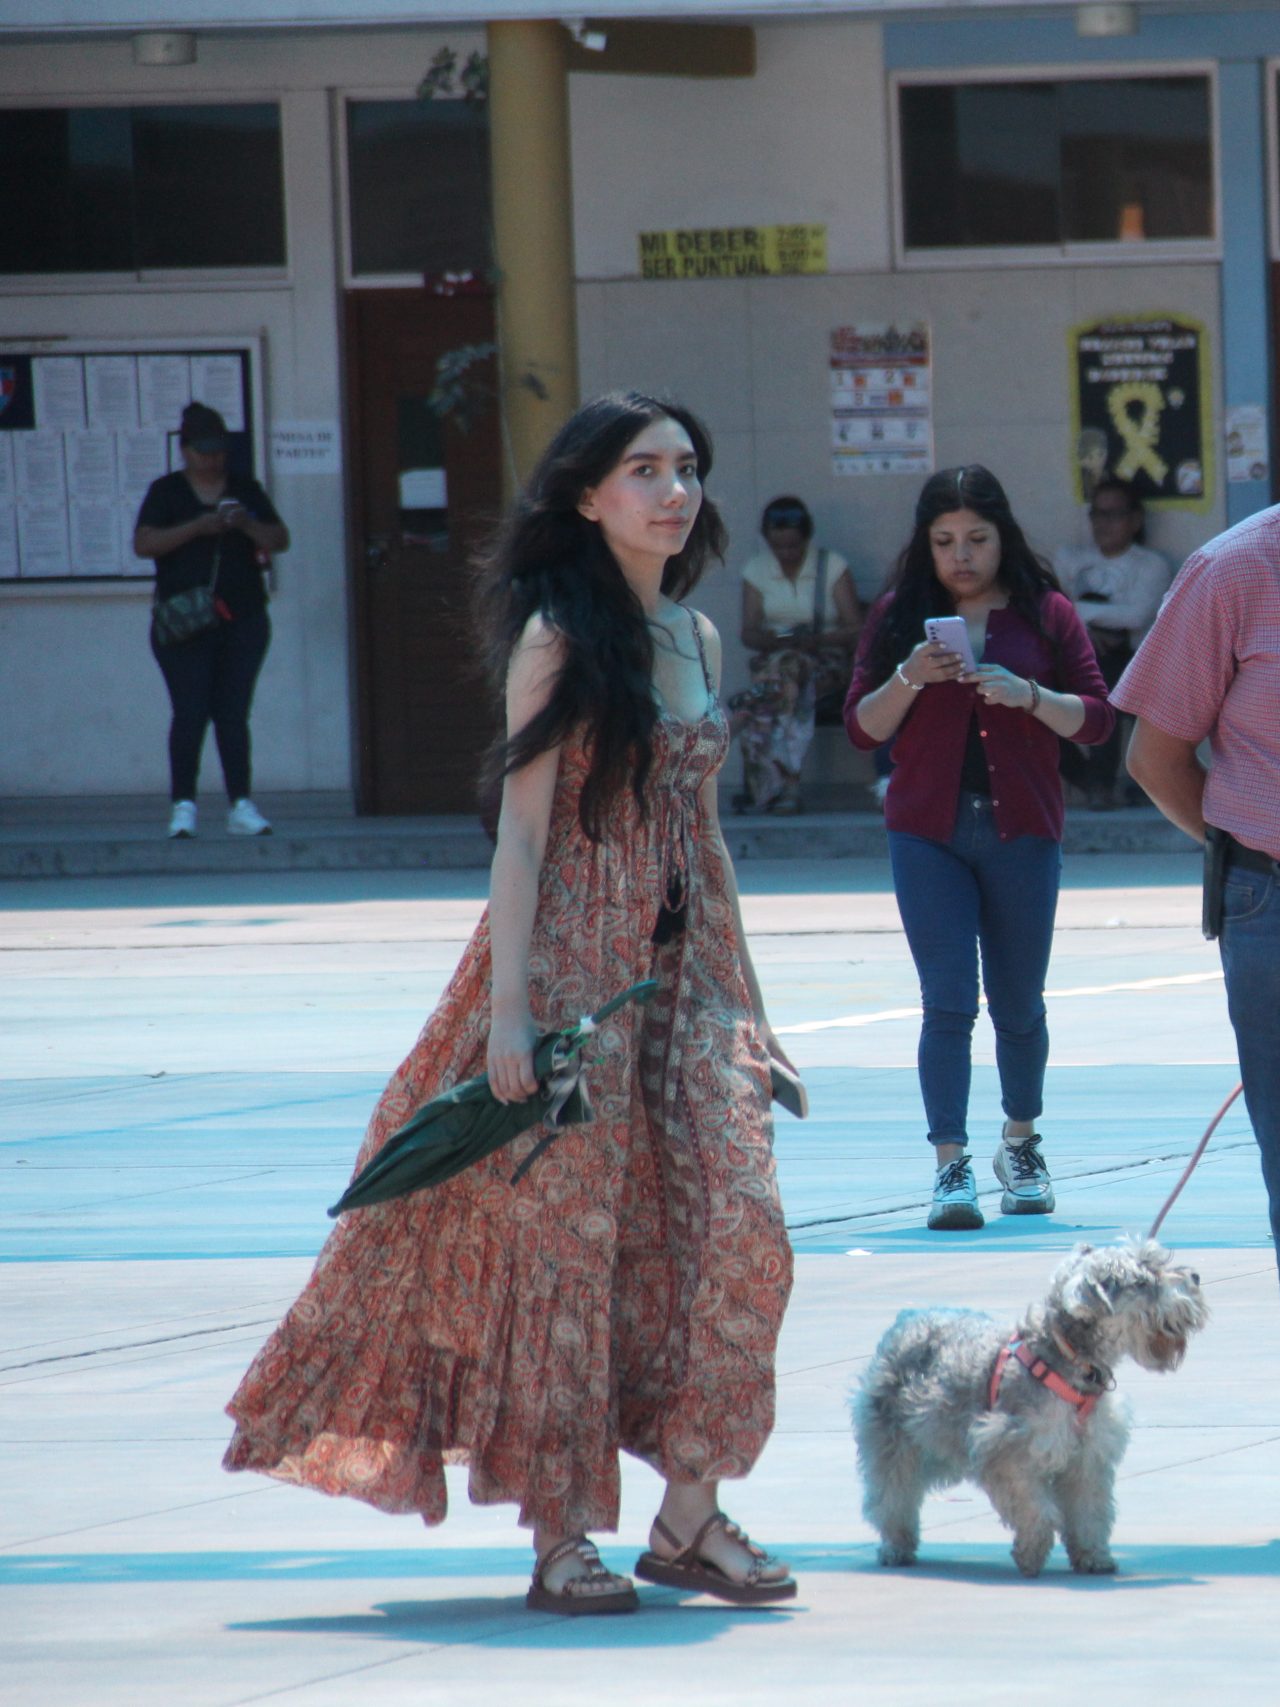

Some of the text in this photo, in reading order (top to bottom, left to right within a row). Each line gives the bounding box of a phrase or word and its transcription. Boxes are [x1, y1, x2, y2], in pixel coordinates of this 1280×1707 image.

[640, 232, 667, 254] MI
[642, 256, 677, 279] SER
[683, 253, 771, 277] PUNTUAL
